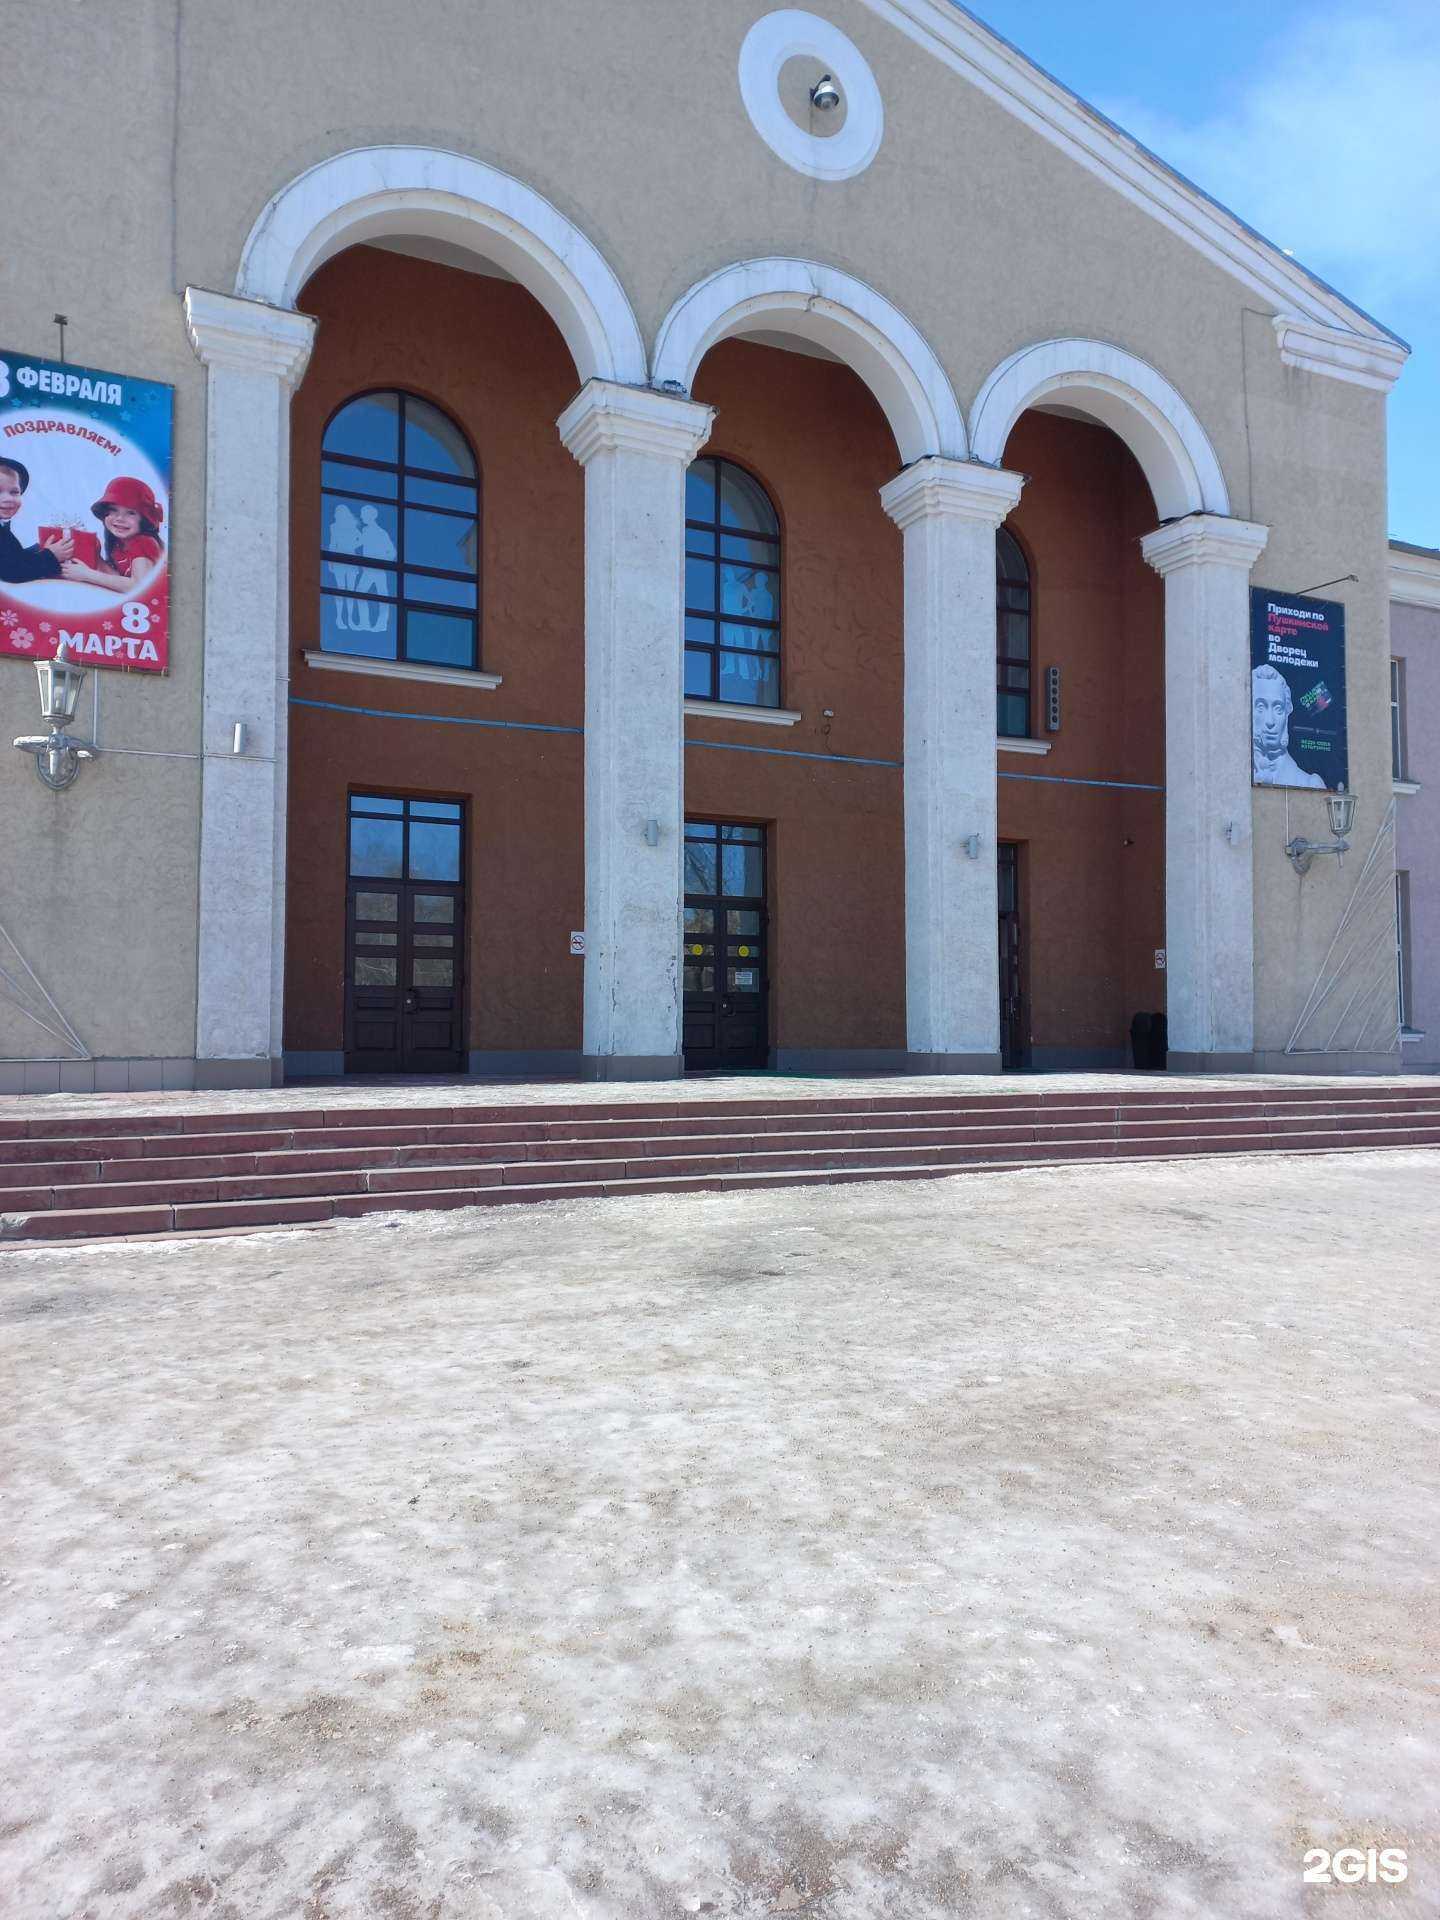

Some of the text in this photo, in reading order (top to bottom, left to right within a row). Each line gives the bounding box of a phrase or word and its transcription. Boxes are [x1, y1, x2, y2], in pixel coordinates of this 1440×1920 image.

[16, 366, 122, 406] ФЕВРАЛЯ
[3, 420, 122, 456] ПОЗДРАВЛЯЕМ!
[121, 601, 150, 634] 8
[1267, 602, 1325, 621] Приходи по
[1267, 612, 1329, 632] Пушкинской
[58, 629, 158, 662] МАРТА
[1268, 634, 1281, 643] во
[1268, 642, 1307, 658] Дворец
[1268, 653, 1319, 668] молодежи
